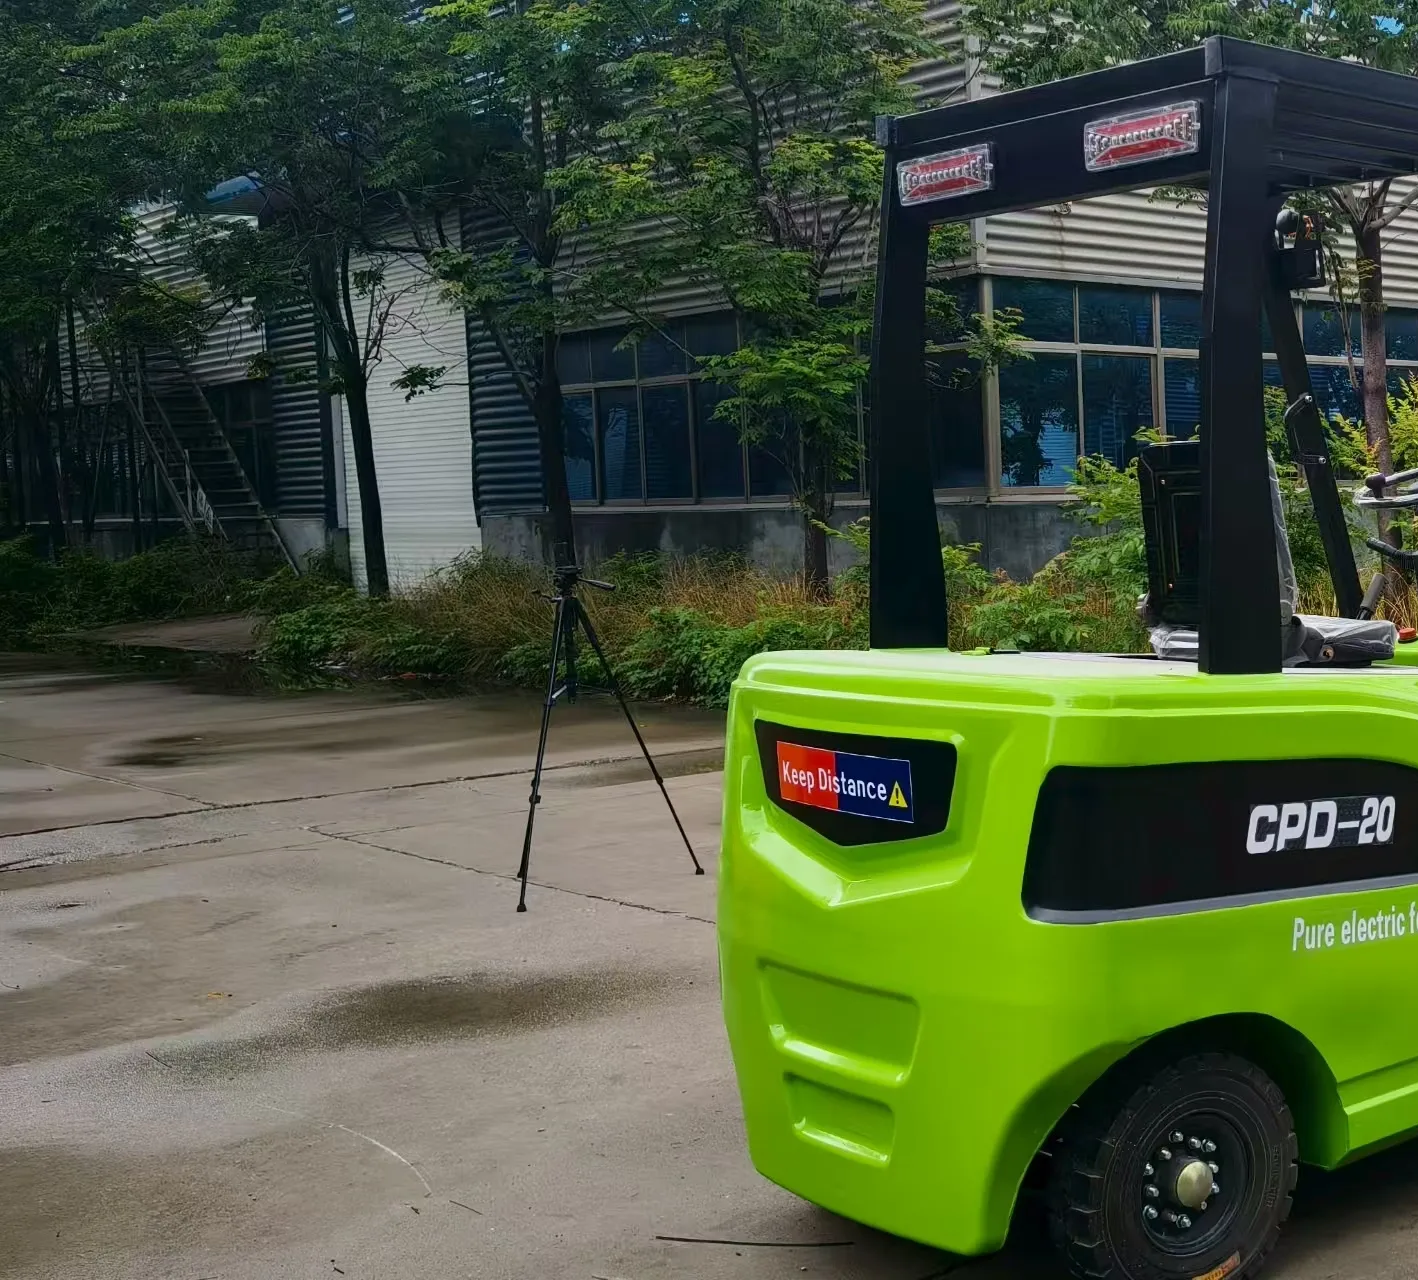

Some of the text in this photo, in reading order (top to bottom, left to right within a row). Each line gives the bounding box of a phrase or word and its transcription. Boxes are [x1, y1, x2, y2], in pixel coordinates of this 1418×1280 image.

[782, 760, 888, 801] Keep Distance
[1246, 796, 1396, 854] CPD-20
[1292, 917, 1335, 951] Pure
[1341, 905, 1405, 945] electric
